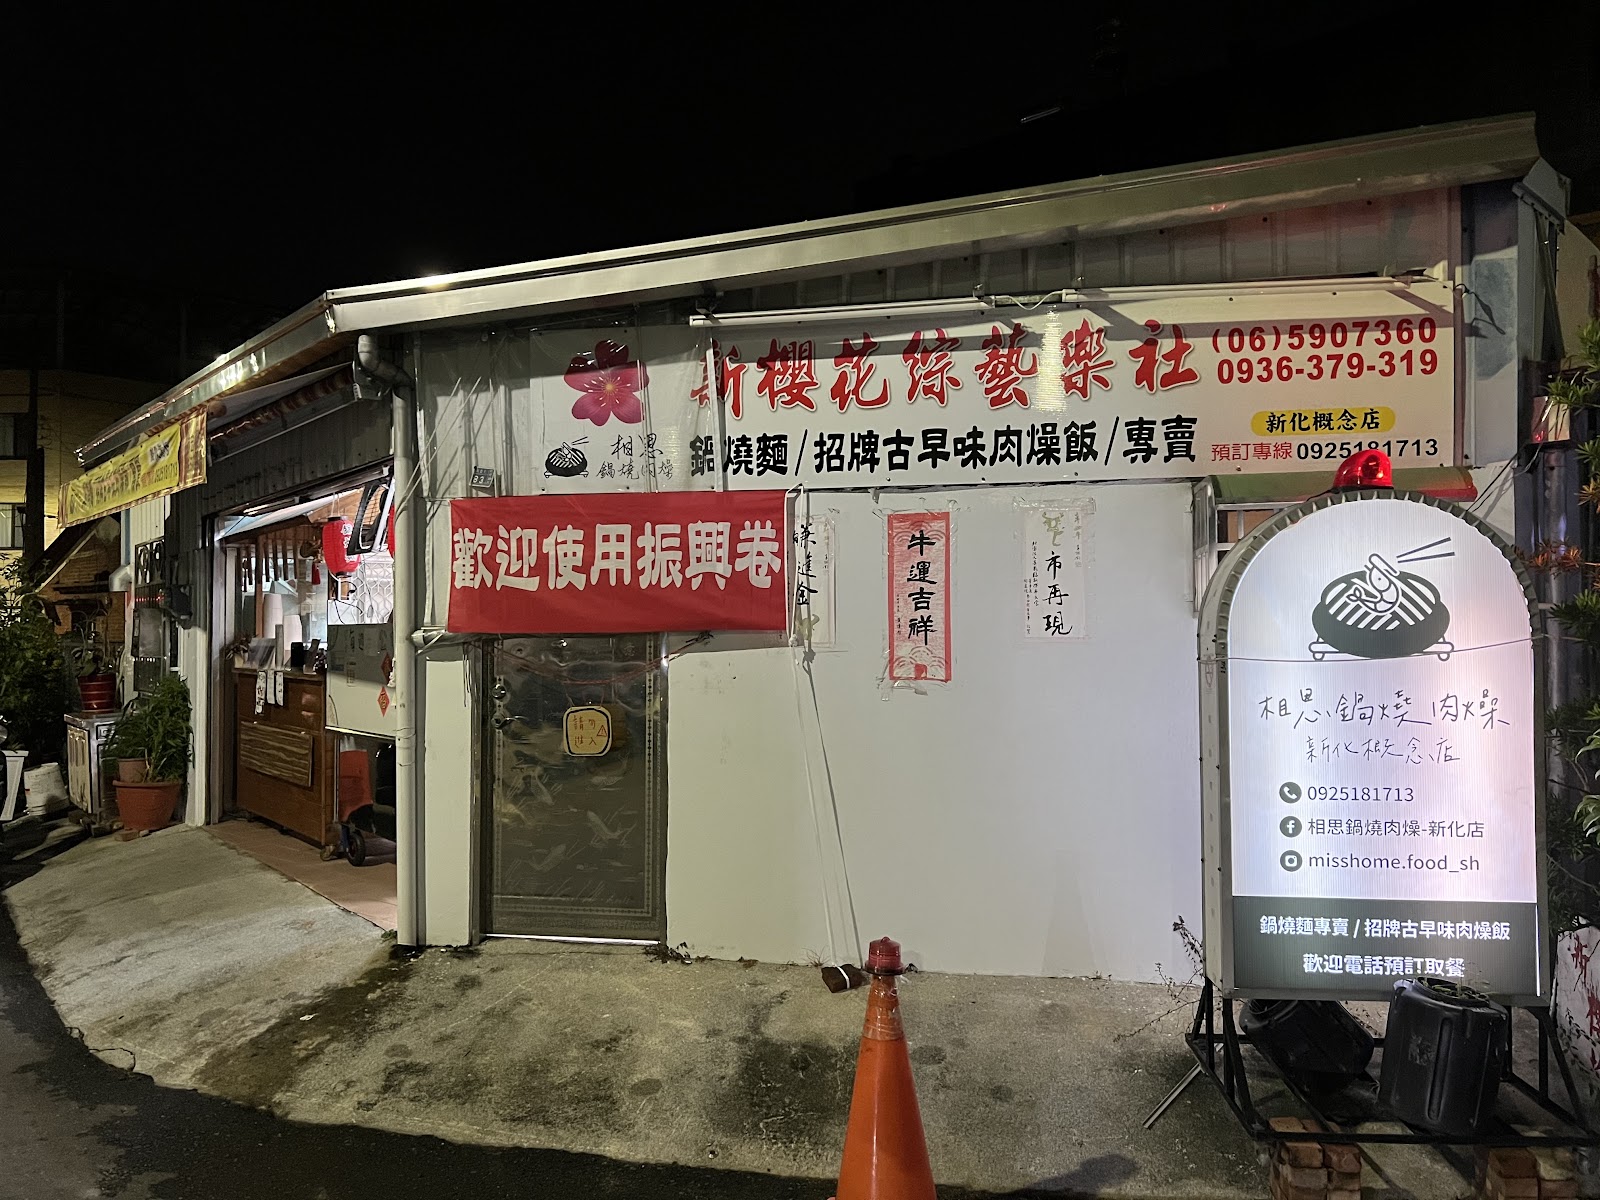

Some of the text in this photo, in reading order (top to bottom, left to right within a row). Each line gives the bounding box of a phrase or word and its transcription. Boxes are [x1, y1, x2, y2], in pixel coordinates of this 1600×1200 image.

[1212, 317, 1437, 353] (06)5907360
[690, 318, 1200, 419] 新櫻花綜藝樂社
[1217, 349, 1438, 384] 0936-379-319
[1265, 408, 1381, 434] 新化概念店
[1211, 442, 1293, 461] 預訂專線
[452, 519, 782, 592] 歡迎使用振興卷
[907, 529, 938, 646] 牛運吉祥
[1259, 688, 1511, 729] 相思鍋燒肉燥
[1306, 736, 1461, 765] 新化概念店
[1307, 786, 1415, 802] 0925181713
[1307, 818, 1485, 839] 相思鍋燒肉燥-新化店
[1309, 852, 1480, 873] misshome.food_sh
[1260, 915, 1349, 937] 鍋燒麵專賣
[1364, 918, 1511, 941] 招牌古早味肉燥飯
[1303, 953, 1466, 978] 歡迎電話預訂取餐
